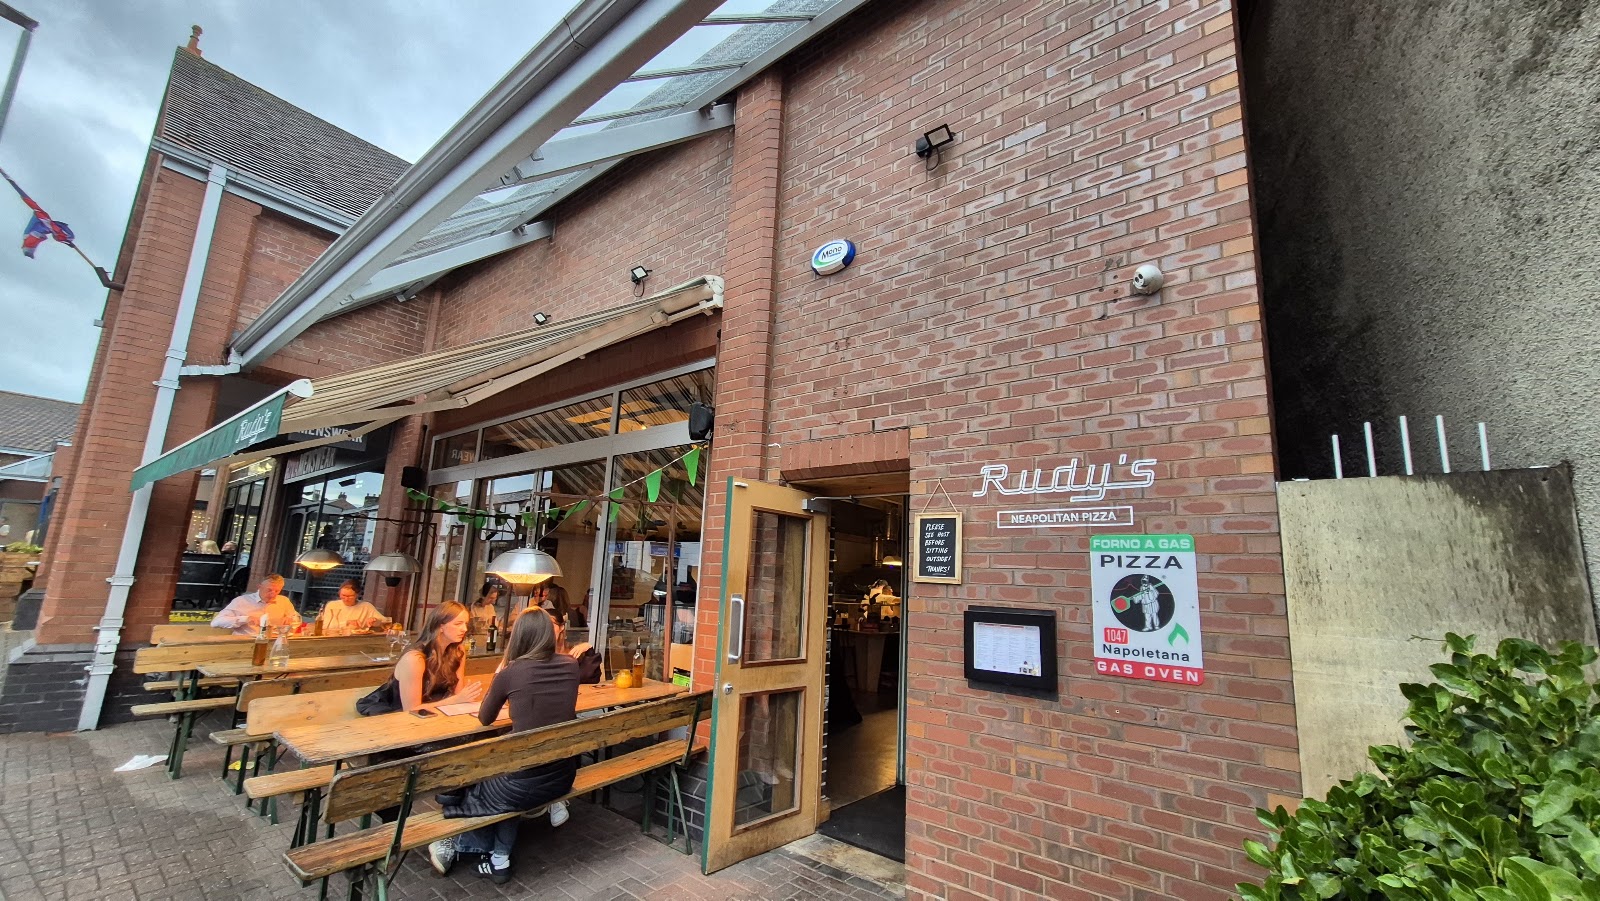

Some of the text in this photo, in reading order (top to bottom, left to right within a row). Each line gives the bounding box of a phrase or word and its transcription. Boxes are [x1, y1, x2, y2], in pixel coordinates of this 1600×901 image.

[235, 408, 272, 443] Rudy's
[972, 453, 1157, 502] Rudy's
[1011, 511, 1117, 524] NEAPOLITAN PIZZA
[1093, 538, 1190, 549] FORNO A GAS
[1100, 554, 1183, 570] PIZZA
[1106, 629, 1127, 642] 1047
[1102, 643, 1190, 662] Napoletana
[1097, 661, 1199, 682] GAS OVEN
